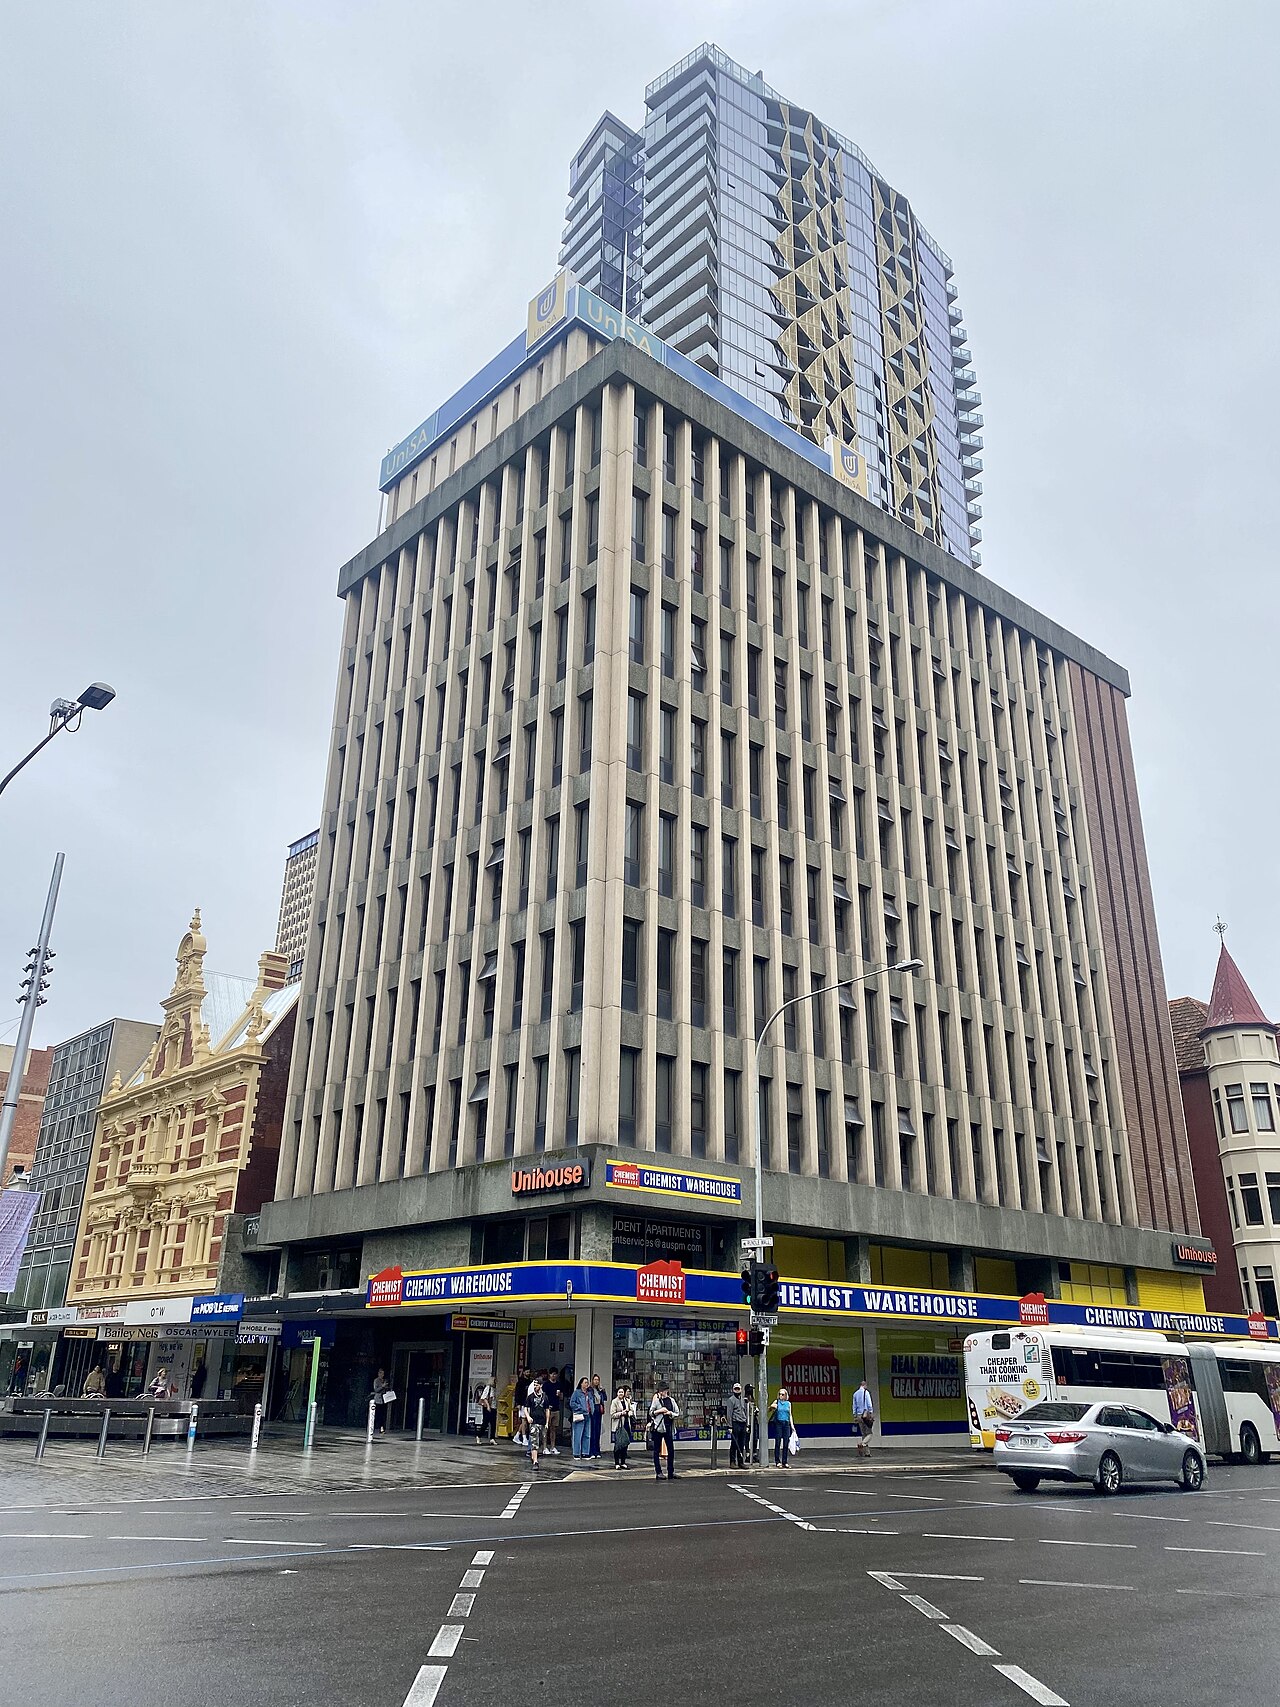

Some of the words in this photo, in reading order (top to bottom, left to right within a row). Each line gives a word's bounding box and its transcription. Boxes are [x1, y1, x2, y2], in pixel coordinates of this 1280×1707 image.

[534, 314, 557, 337] UniSA
[587, 298, 652, 356] UnSA
[387, 429, 427, 474] UniSA
[512, 1165, 582, 1192] Unihouse
[614, 1170, 639, 1180] CHEMIST
[644, 1172, 682, 1190] CHEMIST
[686, 1178, 736, 1197] WAREHOUSE
[646, 1224, 701, 1239] APARTMENTS
[1178, 1245, 1217, 1263] Unihouse
[372, 1280, 402, 1294] CHEMIST
[405, 1277, 447, 1297] CHEMIST
[450, 1272, 512, 1294] WAREHOUSE
[640, 1273, 683, 1290] CHEMIST
[640, 1289, 682, 1298] WAREHOUSE
[777, 1284, 853, 1308] HEMIST
[864, 1291, 978, 1317] WAREHOUSE
[1020, 1303, 1047, 1315] CHEMIST
[1085, 1307, 1145, 1327] CHEMIST
[33, 1314, 46, 1322] SILK
[489, 1321, 514, 1329] WAREHOUSE
[105, 1328, 135, 1340] Bailey
[166, 1328, 197, 1336] OSCAR
[204, 1329, 234, 1337] WYLEE
[891, 1355, 915, 1374] REAL
[917, 1355, 959, 1375] BRANDS!
[980, 1366, 998, 1374] THAN
[999, 1365, 1028, 1374] COOKING
[987, 1357, 1018, 1366] CHEAPER
[784, 1364, 837, 1383] CHEMIST
[989, 1375, 997, 1383] AT
[998, 1374, 1021, 1383] HOME!
[785, 1386, 837, 1396] WAREHOUSE
[893, 1378, 917, 1397] REAL
[917, 1379, 960, 1397] SAVINGS!
